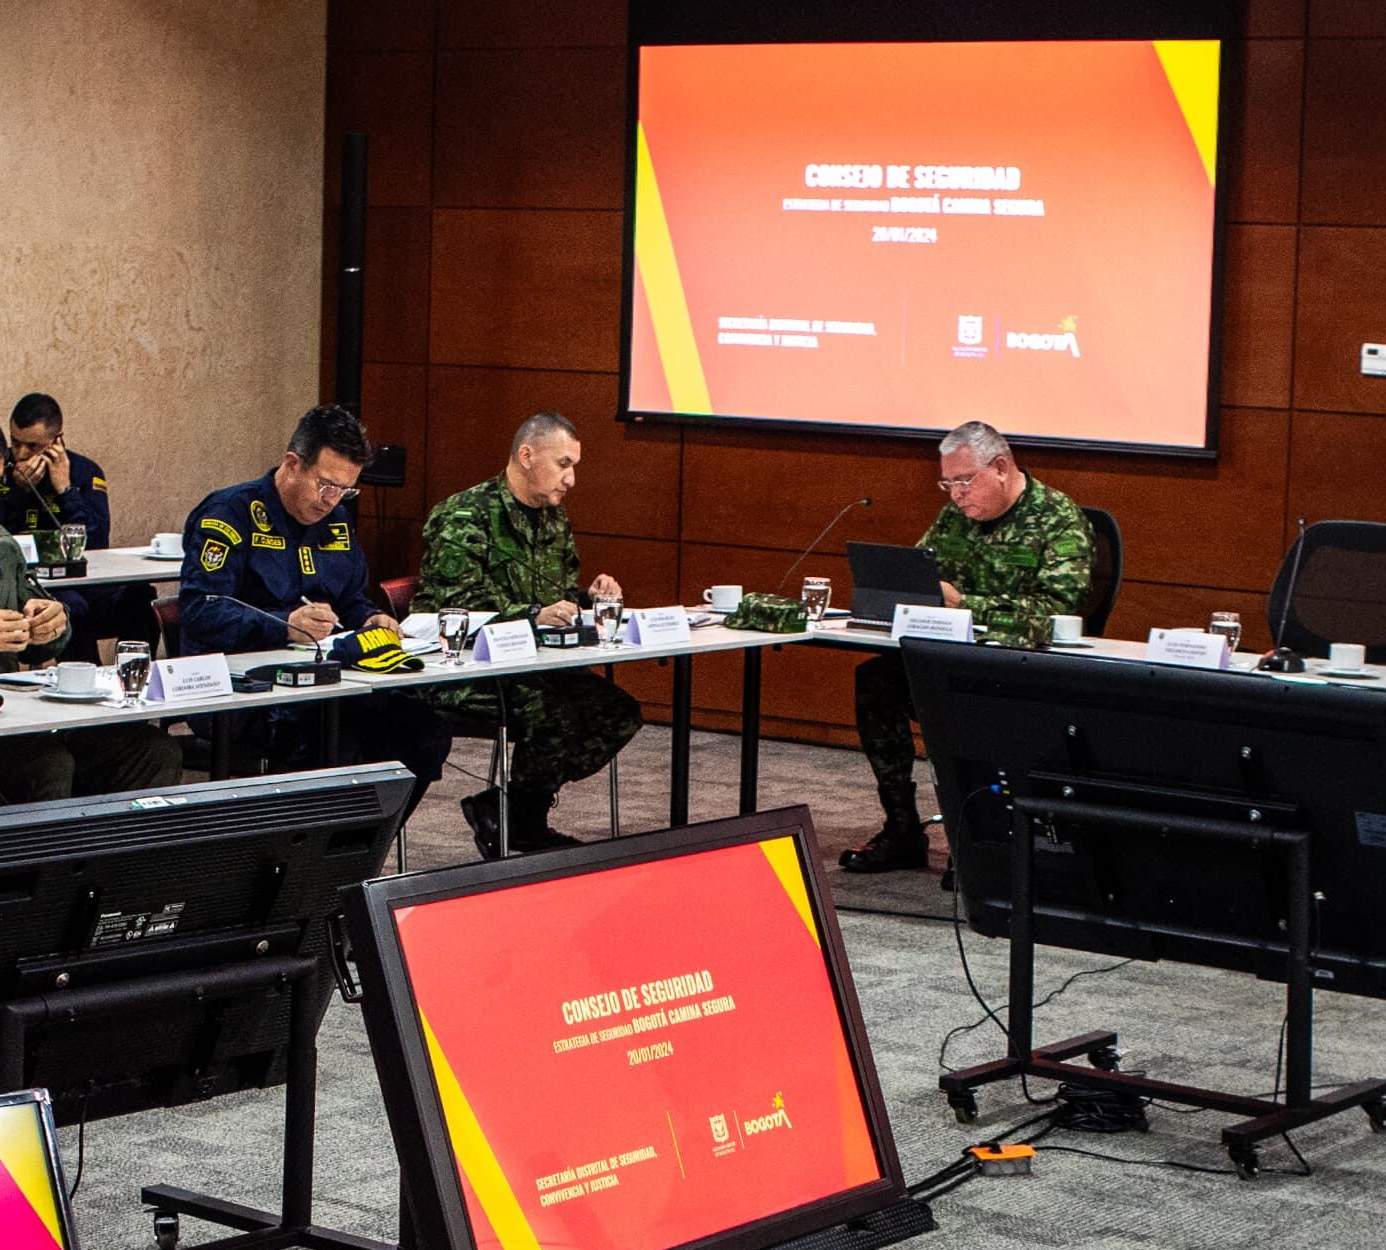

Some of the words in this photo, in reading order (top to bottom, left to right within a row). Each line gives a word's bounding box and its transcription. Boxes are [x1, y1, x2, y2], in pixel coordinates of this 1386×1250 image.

[805, 164, 883, 188] CONSEJO
[885, 165, 911, 188] DE
[914, 165, 1021, 191] SEGURIDAD
[562, 991, 621, 1025] CONSEJO
[621, 986, 641, 1011] DE
[641, 969, 714, 1006] SEGURIDAD
[590, 1032, 600, 1044] DE
[632, 1008, 669, 1033] BOGOTÁ
[668, 1003, 702, 1025] CAMINA
[702, 995, 736, 1016] SEGURA
[627, 1040, 674, 1066] 20/01/2024
[609, 1156, 619, 1170] DE
